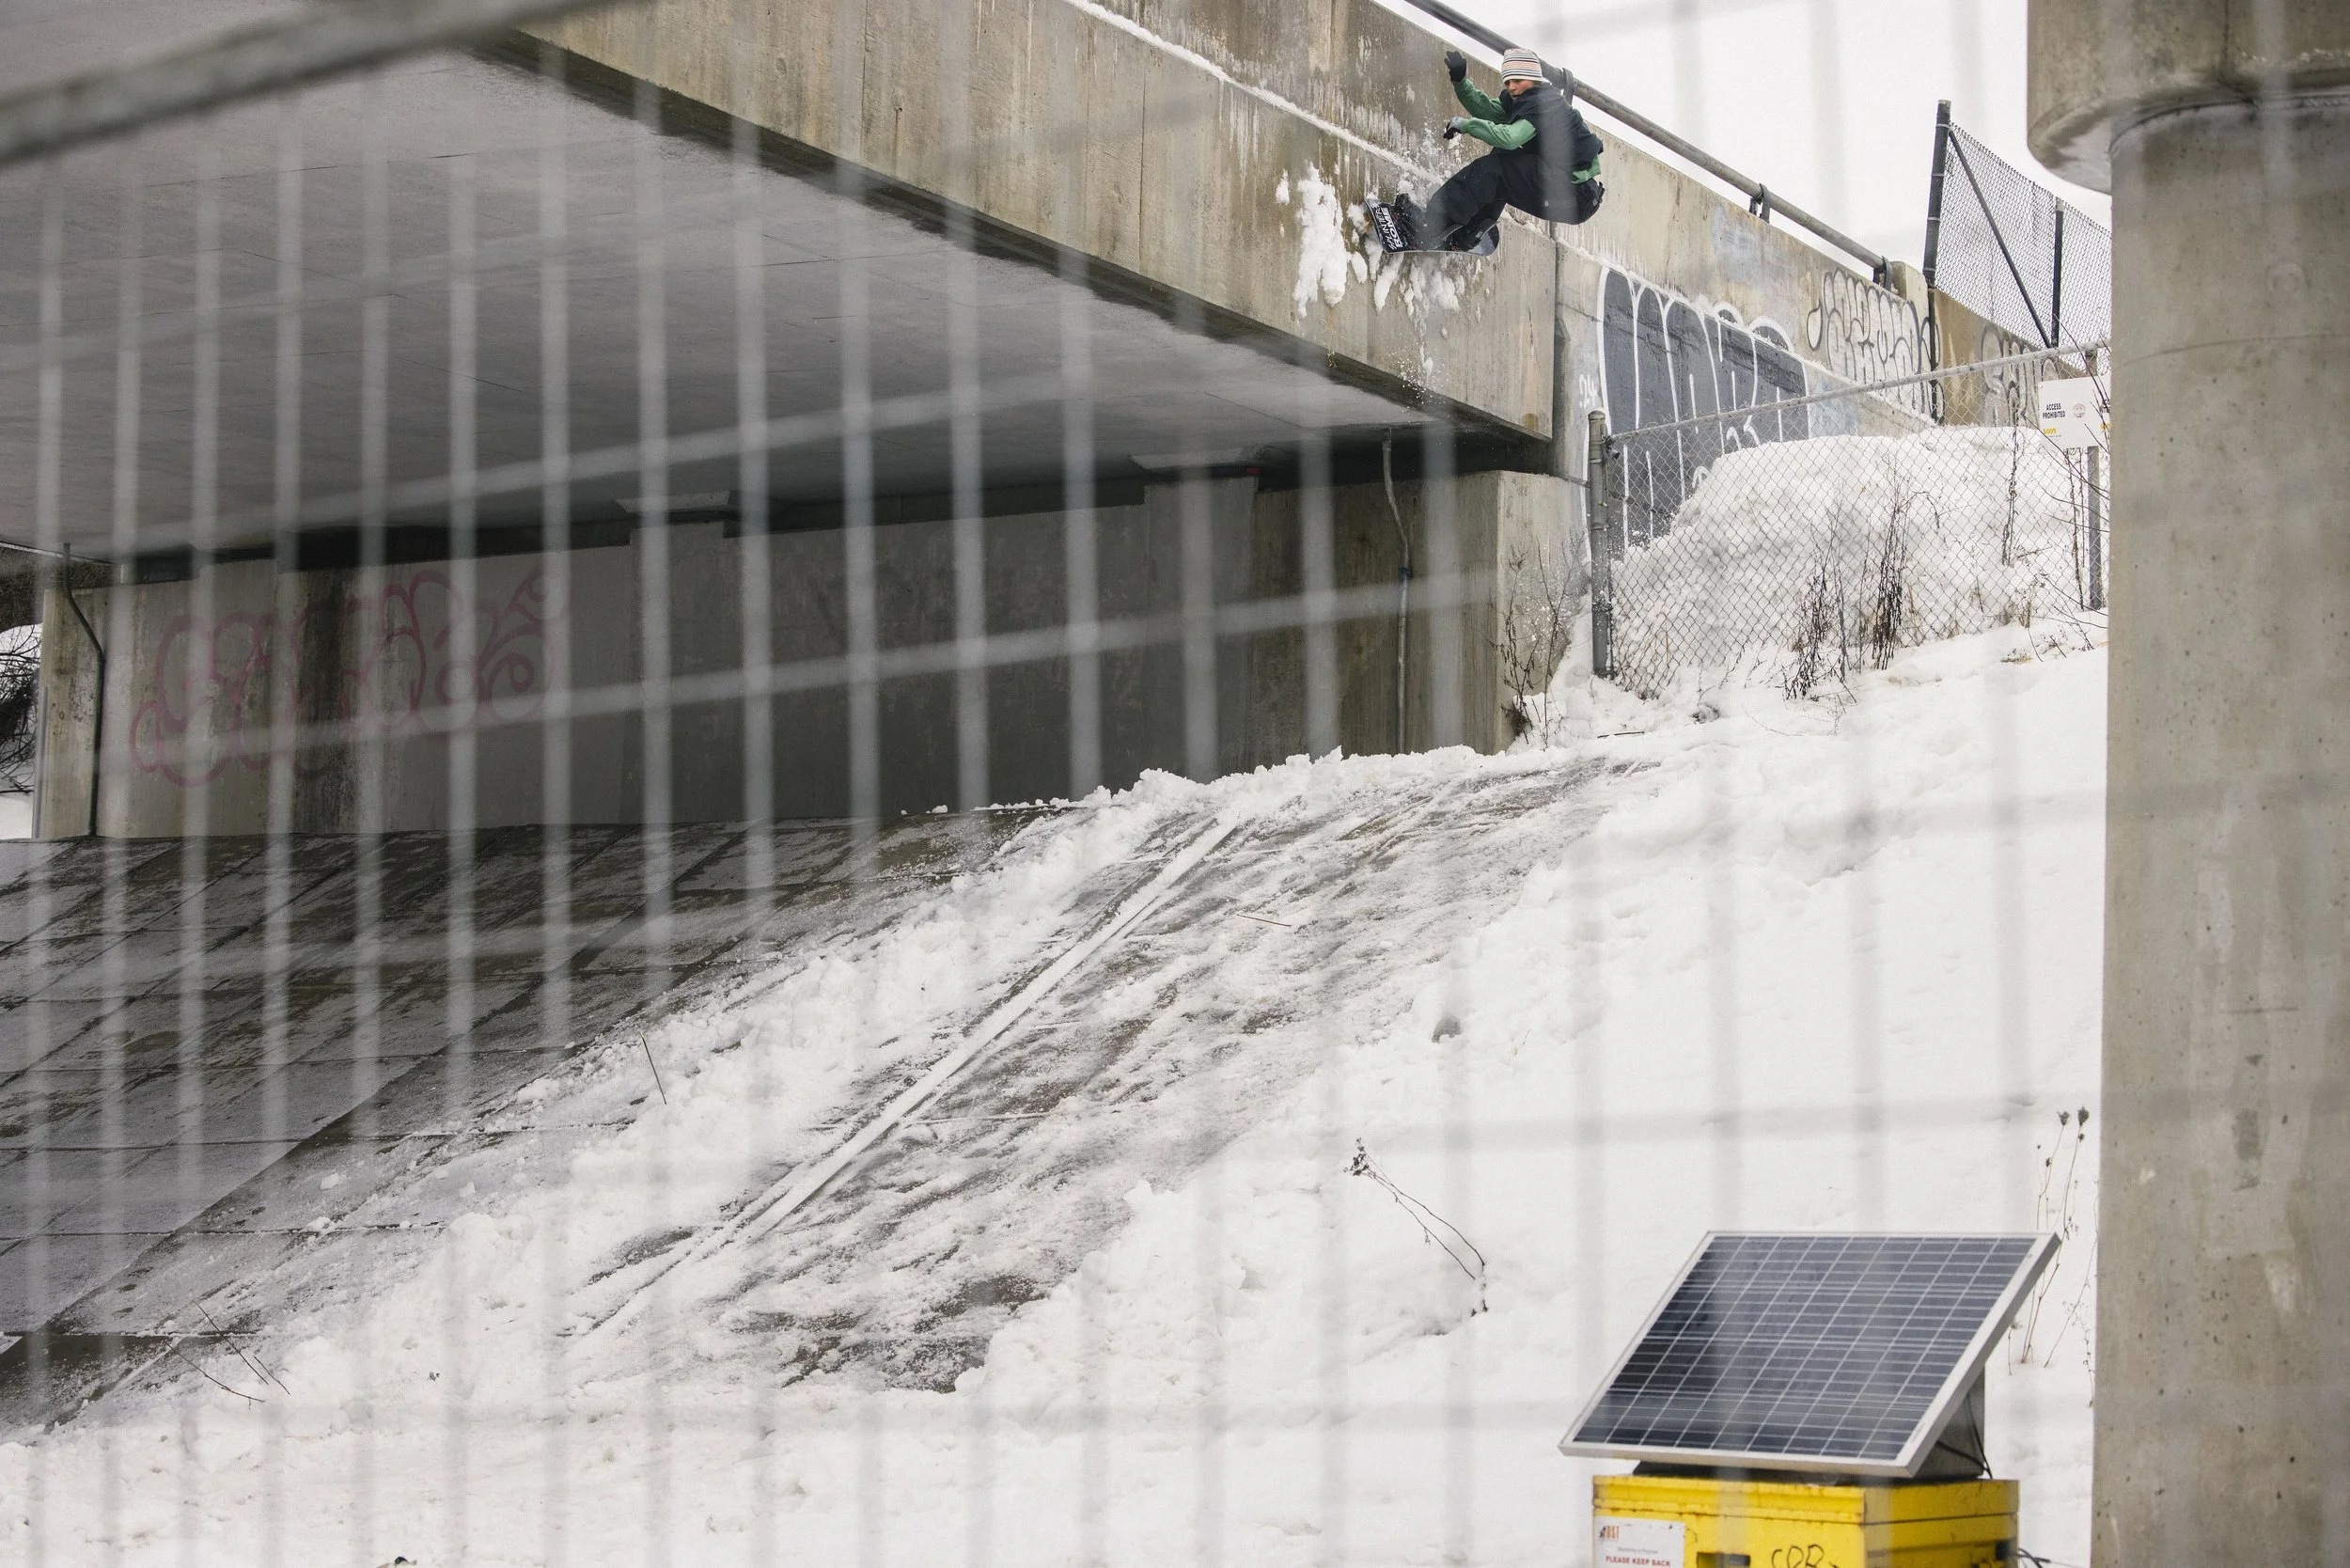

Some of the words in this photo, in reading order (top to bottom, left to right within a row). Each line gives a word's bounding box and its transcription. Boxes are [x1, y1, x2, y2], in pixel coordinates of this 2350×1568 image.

[1381, 207, 1403, 248] ROME
[2046, 402, 2061, 411] ACCESS
[2043, 411, 2066, 419] PROHIBITED
[1606, 1556, 1630, 1564] PLEASE
[1632, 1557, 1650, 1566] KEEP
[1652, 1559, 1671, 1567] BACK
